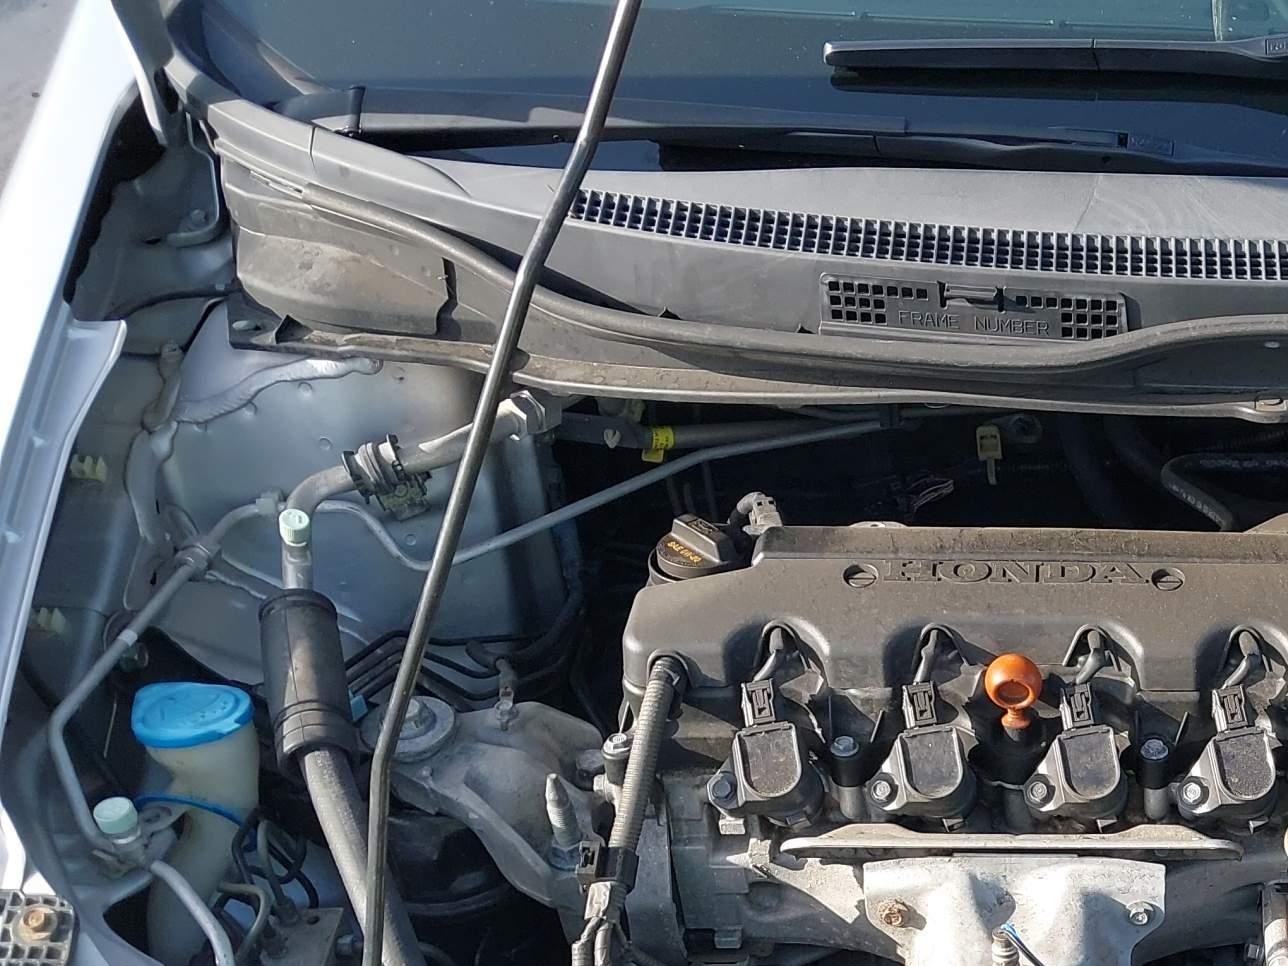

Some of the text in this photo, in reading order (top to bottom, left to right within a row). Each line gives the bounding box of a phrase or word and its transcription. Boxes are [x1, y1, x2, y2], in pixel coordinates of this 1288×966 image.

[899, 310, 1050, 336] FRAME NUMBER
[882, 559, 1150, 584] HONDA
